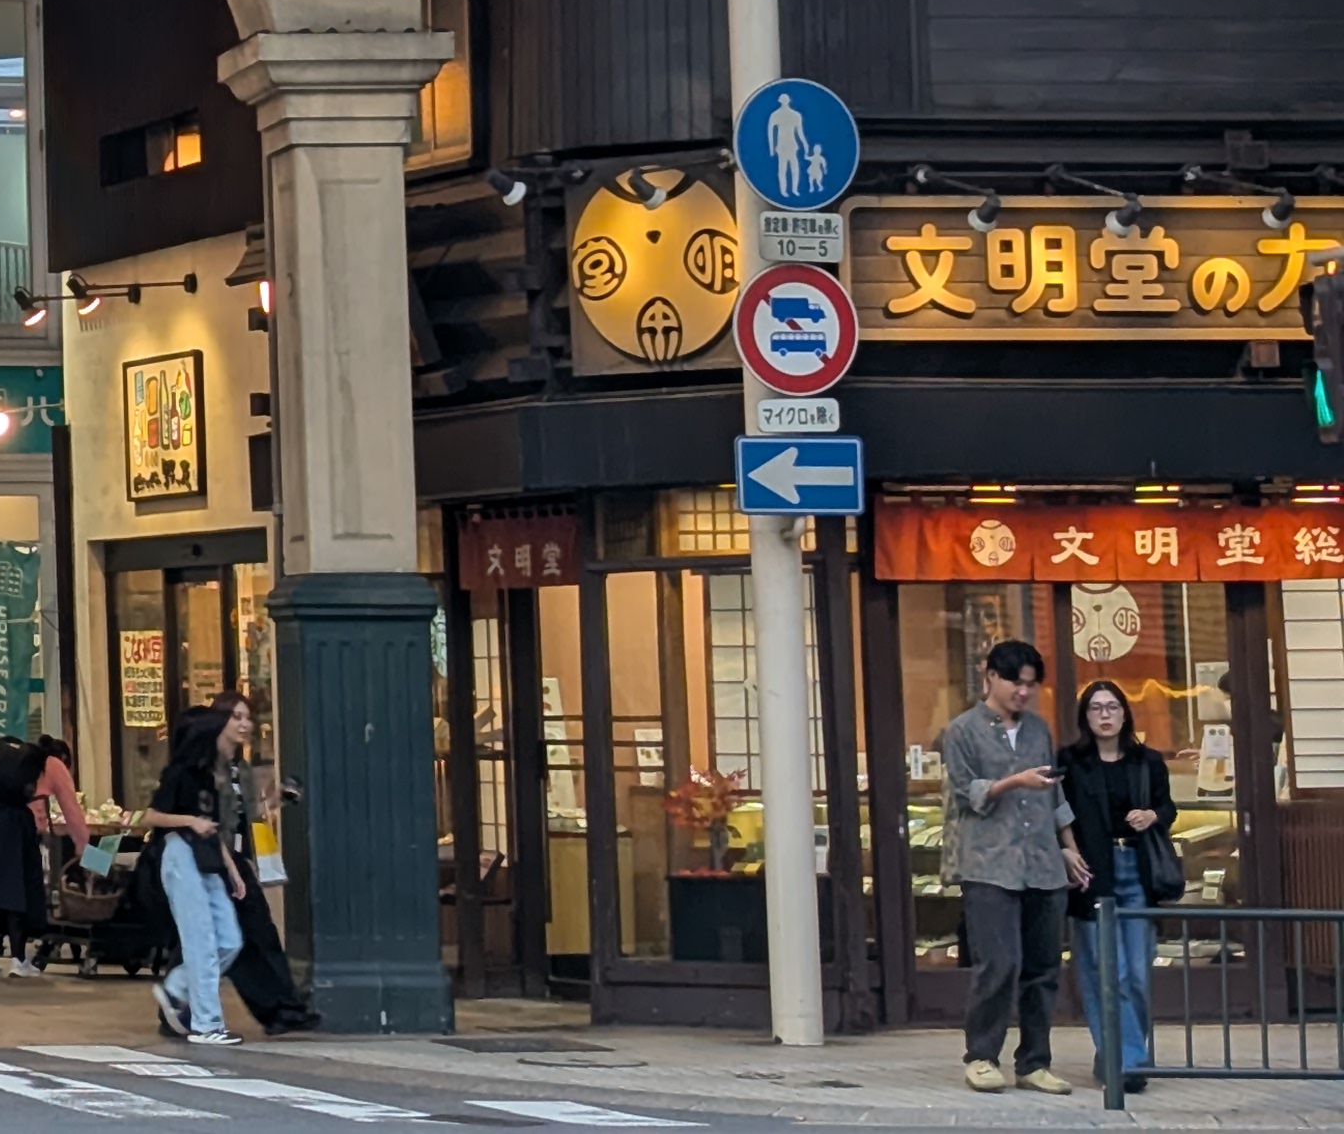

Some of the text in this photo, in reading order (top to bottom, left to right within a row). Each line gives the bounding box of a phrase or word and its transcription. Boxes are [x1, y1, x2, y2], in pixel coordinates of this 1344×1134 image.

[761, 406, 836, 425] マイクロを除く
[486, 542, 562, 577] 文明堂
